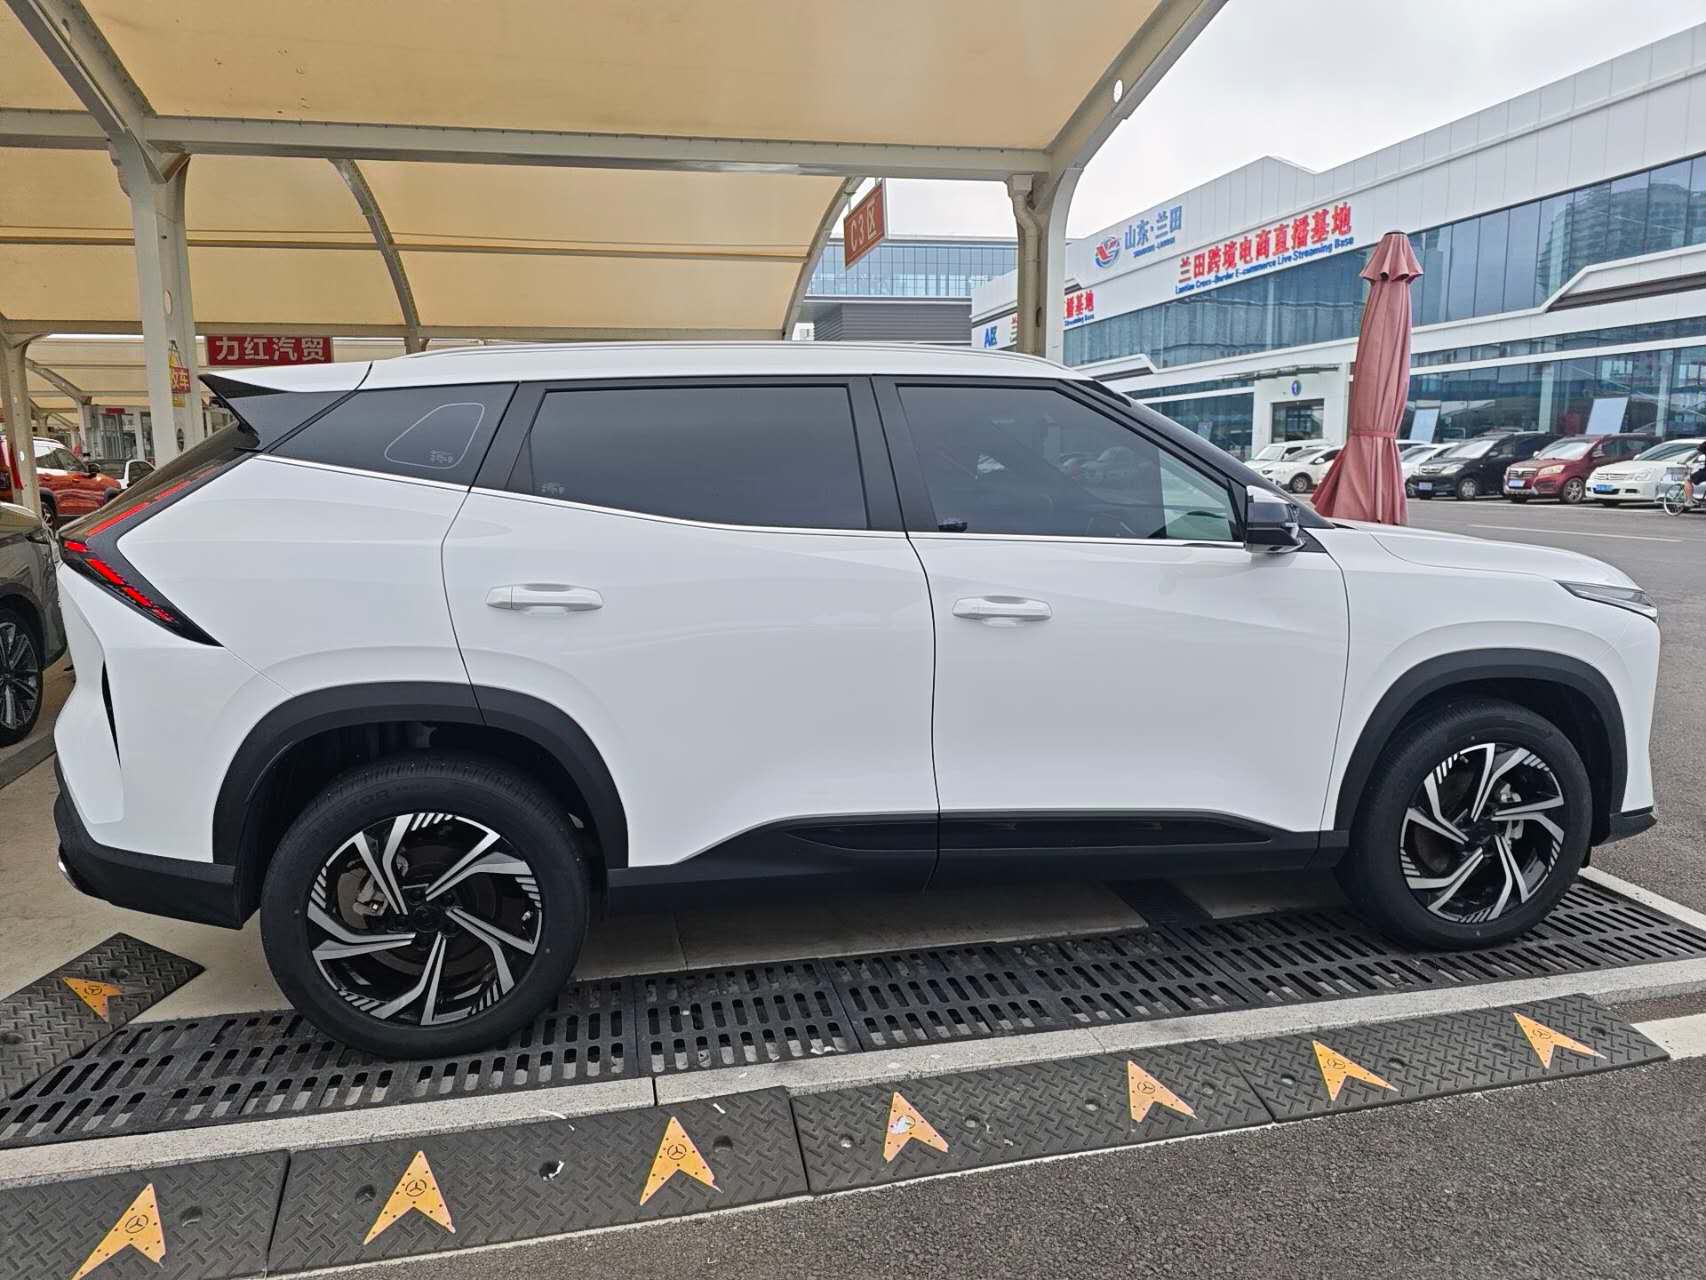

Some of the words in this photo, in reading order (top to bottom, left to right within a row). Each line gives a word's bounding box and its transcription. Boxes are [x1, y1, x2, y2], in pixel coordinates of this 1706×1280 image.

[850, 196, 877, 252] C3区
[1178, 201, 1352, 283] 兰田跨境电商直播基地
[1277, 254, 1292, 265] Live
[1293, 243, 1333, 261] Streaming
[1334, 236, 1354, 249] Base
[215, 336, 325, 361] 力红汽贸
